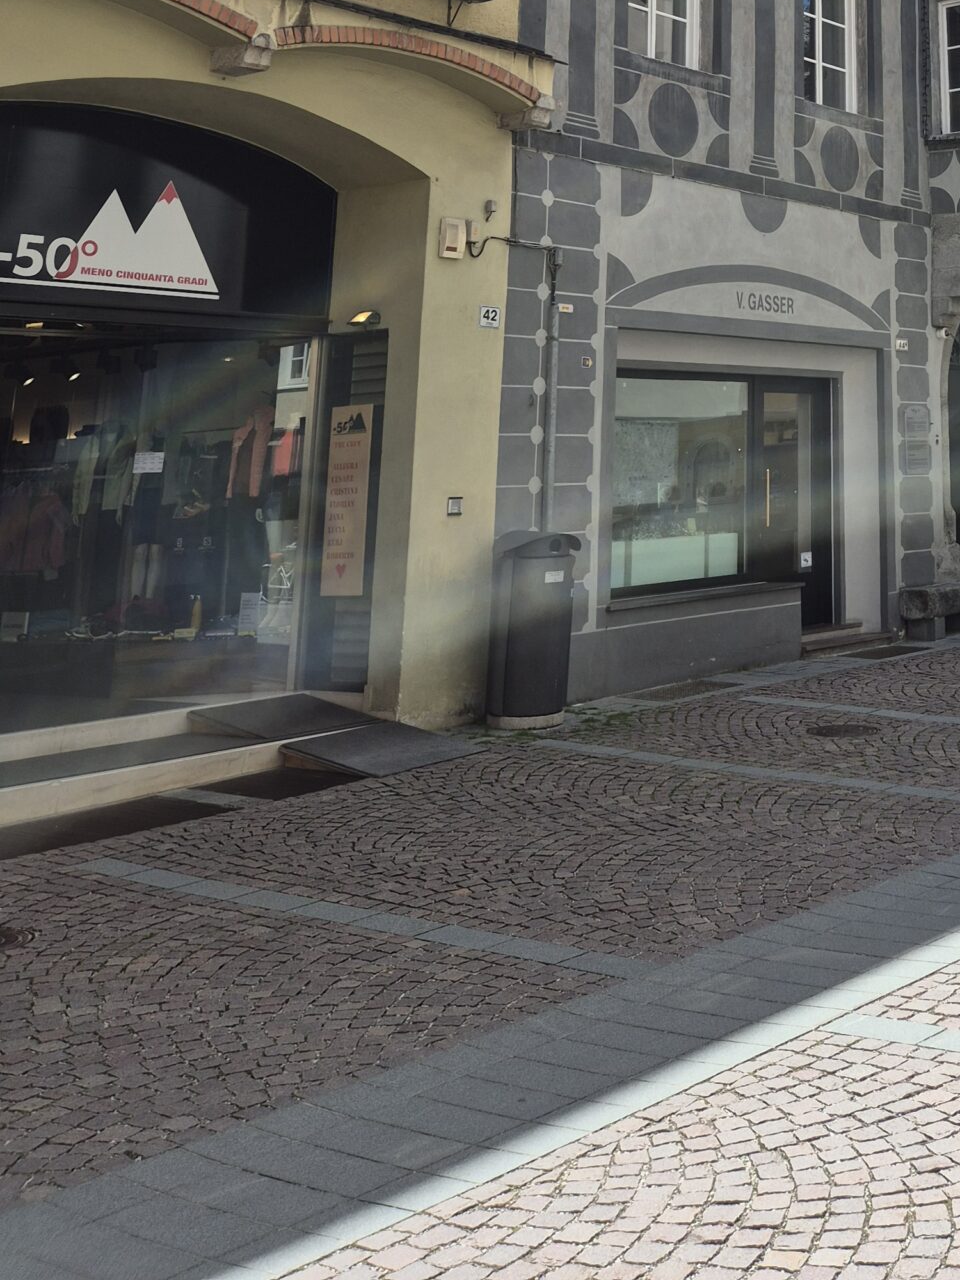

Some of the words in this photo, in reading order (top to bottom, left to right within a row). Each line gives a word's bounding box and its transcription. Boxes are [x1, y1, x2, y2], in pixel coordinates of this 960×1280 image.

[80, 267, 113, 278] MENO
[116, 270, 175, 284] CINQUANTA
[177, 276, 208, 287] GRADI
[736, 291, 745, 309] V.
[748, 292, 794, 314] GASSER
[483, 309, 498, 322] 42
